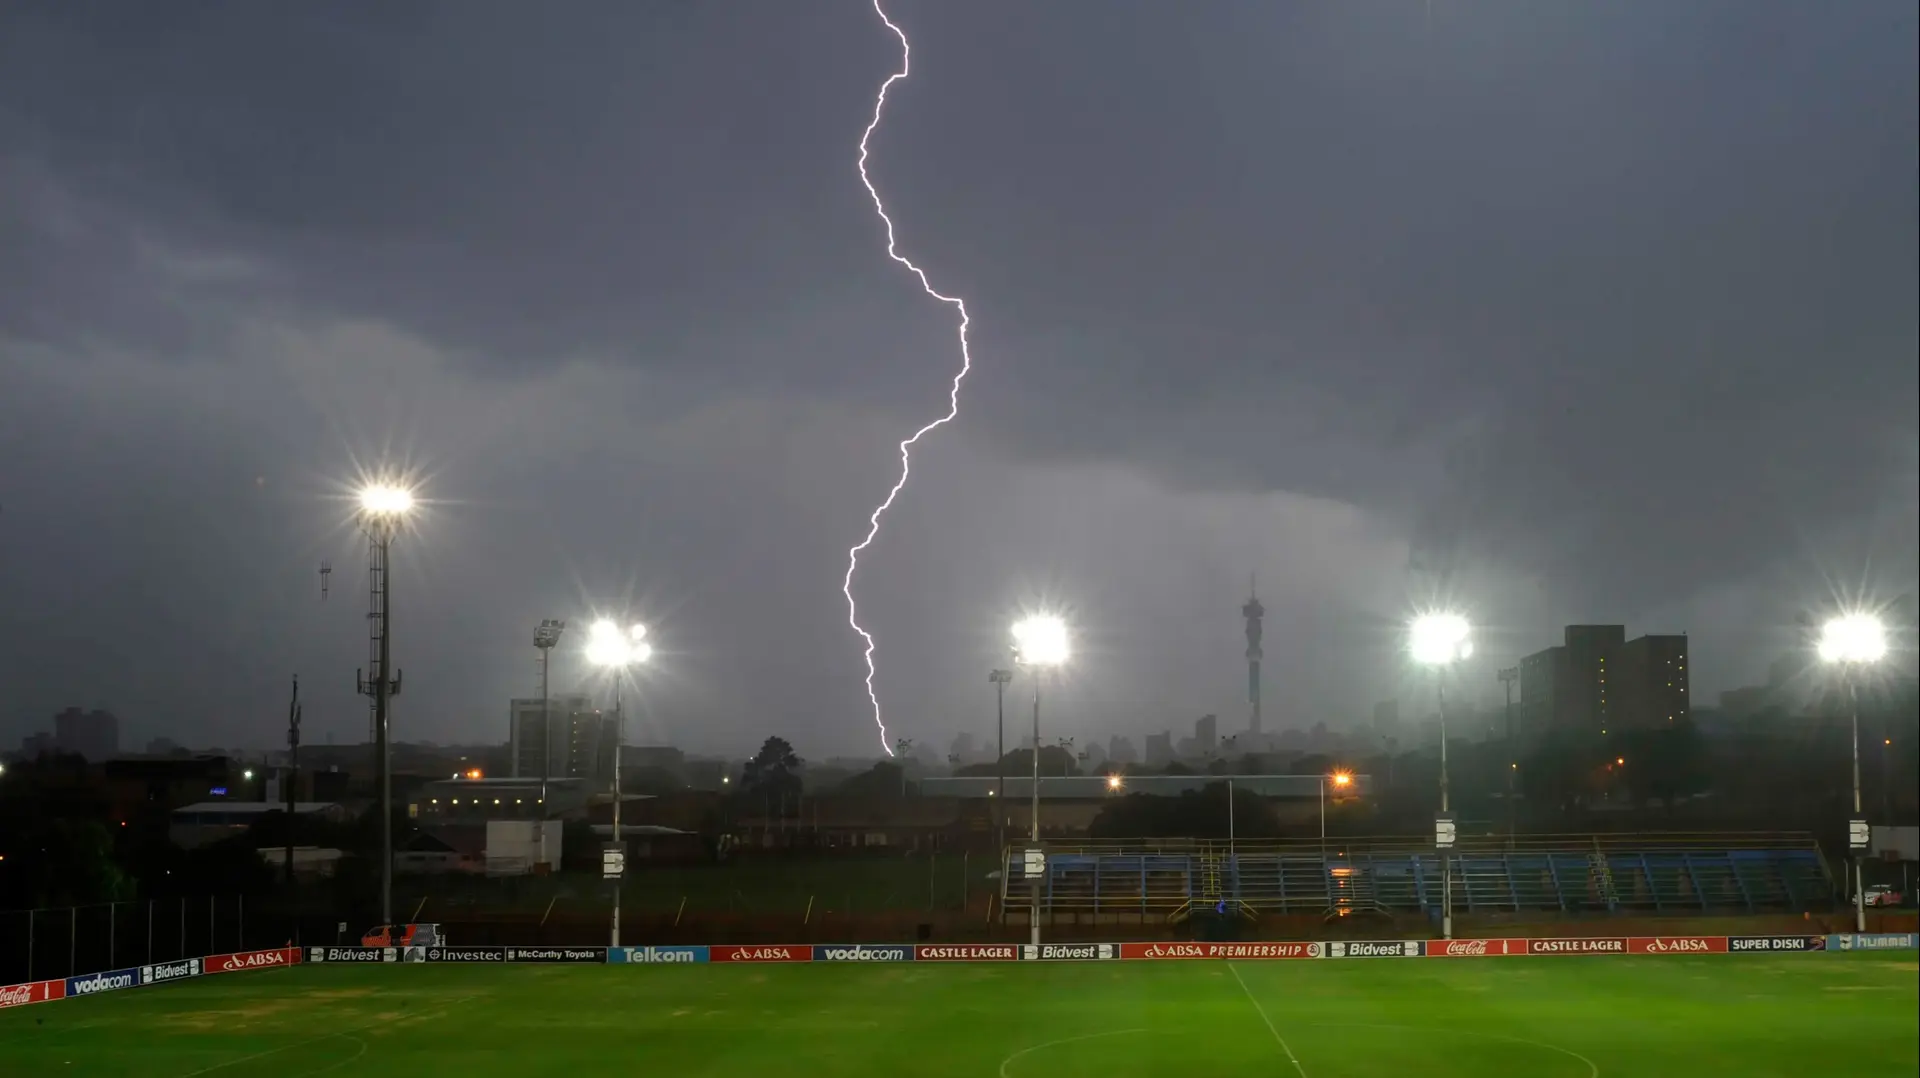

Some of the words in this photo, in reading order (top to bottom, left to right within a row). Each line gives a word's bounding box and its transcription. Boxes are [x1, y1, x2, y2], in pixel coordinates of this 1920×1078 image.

[1533, 941, 1580, 951] CASTLE
[1582, 941, 1622, 951] LAGER
[1669, 939, 1709, 951] ABSA
[1732, 939, 1770, 950] SUPER
[1773, 938, 1805, 949] DISKI
[1857, 934, 1912, 948] hummel
[328, 949, 380, 961] Bidvest
[442, 949, 502, 961] Investec
[518, 949, 562, 959] McCarthy
[564, 950, 595, 959] Toyota
[624, 947, 694, 962] Telkom
[753, 948, 791, 959] ABSA
[824, 945, 903, 960] vodacom
[920, 948, 968, 958] CASTLE
[971, 948, 1012, 958] LAGER
[1042, 946, 1095, 958] Bidvest
[1166, 945, 1204, 956] ABSA
[1210, 945, 1302, 957] PREMIERSHIP
[1349, 943, 1401, 955] Bidvest
[245, 952, 284, 966] ABSA
[155, 962, 189, 980] Bidvest
[74, 972, 132, 994] vodacom
